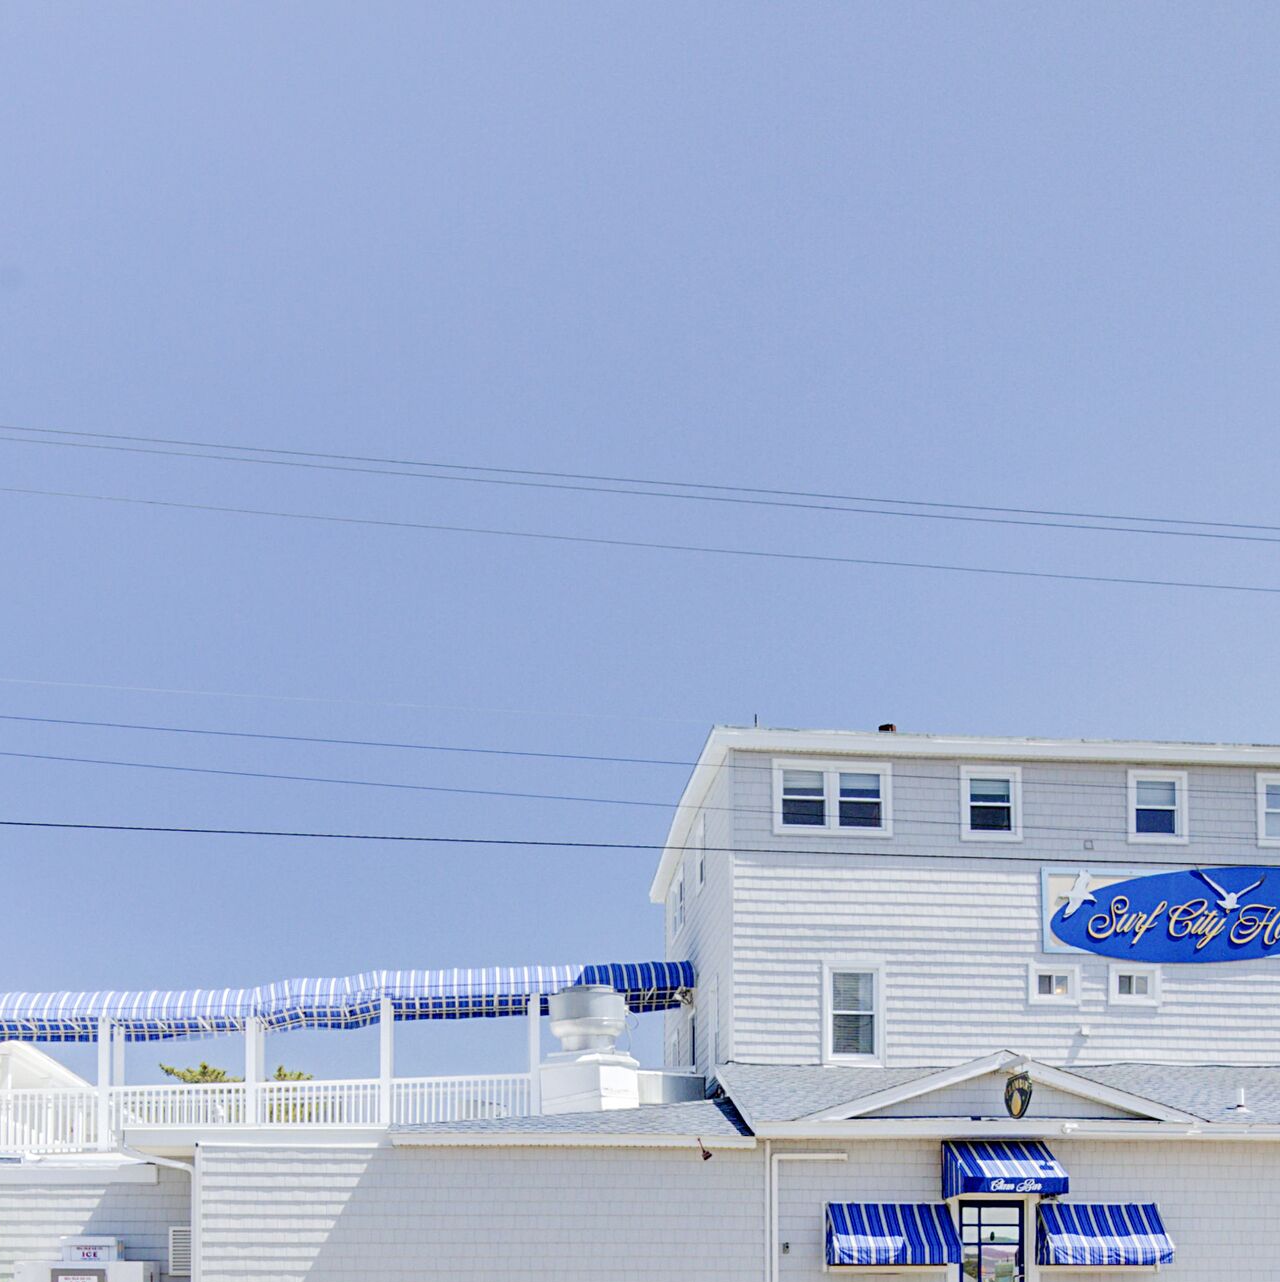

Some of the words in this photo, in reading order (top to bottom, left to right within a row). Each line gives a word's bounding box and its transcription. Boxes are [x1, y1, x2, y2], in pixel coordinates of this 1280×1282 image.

[1087, 896, 1168, 945] Surf
[1168, 899, 1228, 949] City
[991, 1178, 1015, 1191] Clam
[1016, 1178, 1042, 1192] Bar
